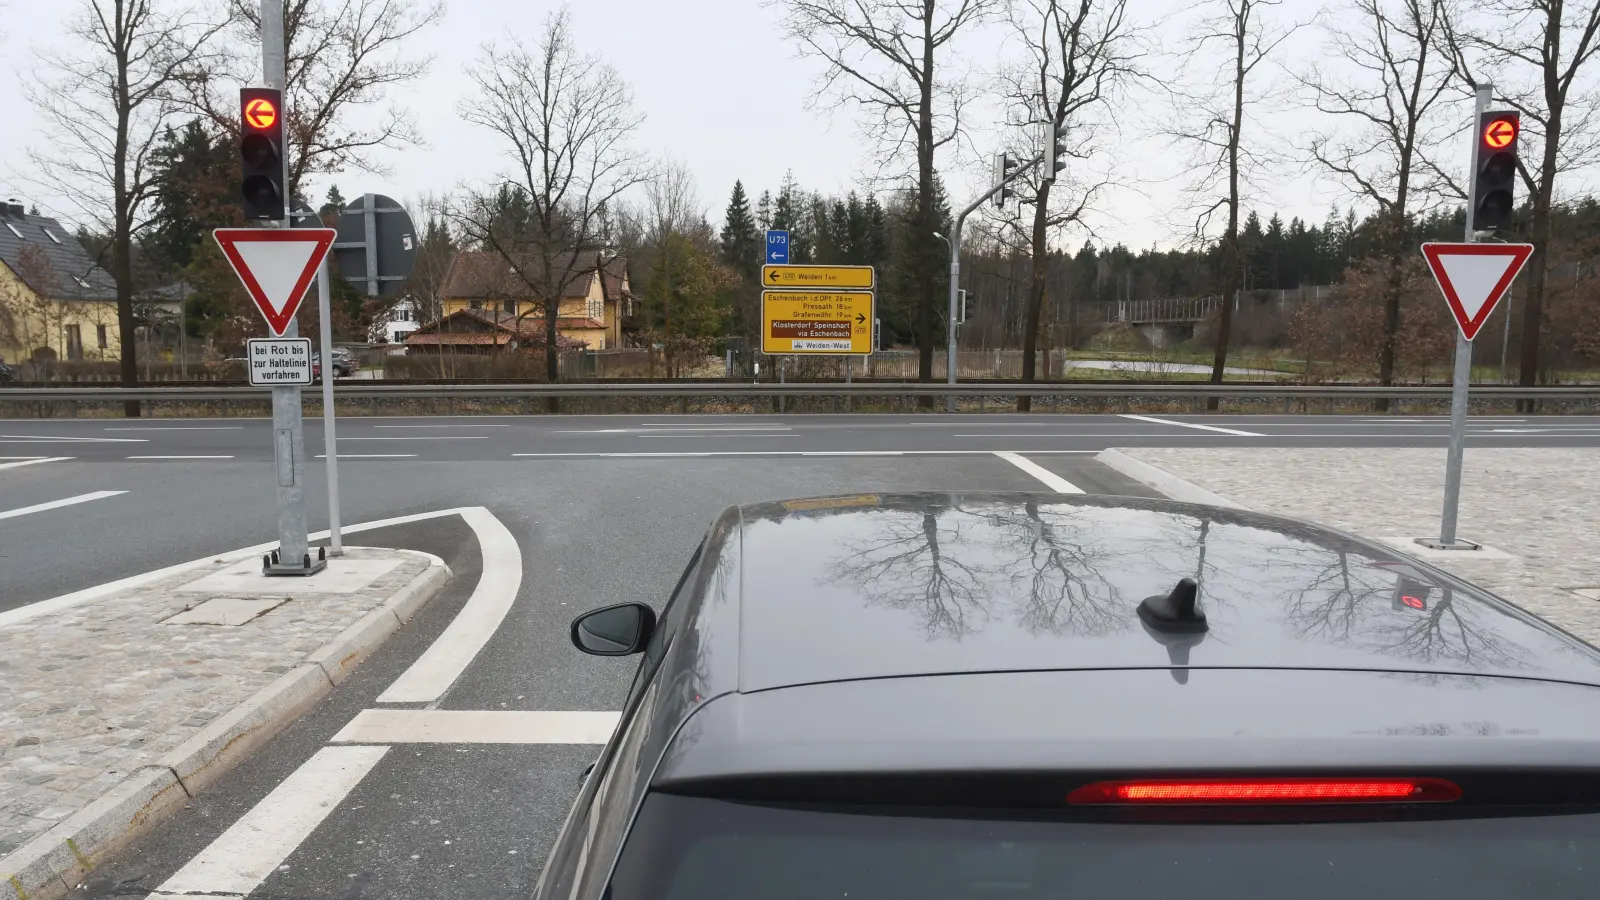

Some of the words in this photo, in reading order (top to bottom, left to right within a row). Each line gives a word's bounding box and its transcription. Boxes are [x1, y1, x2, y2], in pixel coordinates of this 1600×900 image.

[255, 346, 267, 354] bei
[271, 346, 288, 354] Rot
[292, 345, 303, 354] bis
[270, 358, 306, 367] Haltelinie
[262, 370, 300, 379] vorfahren
